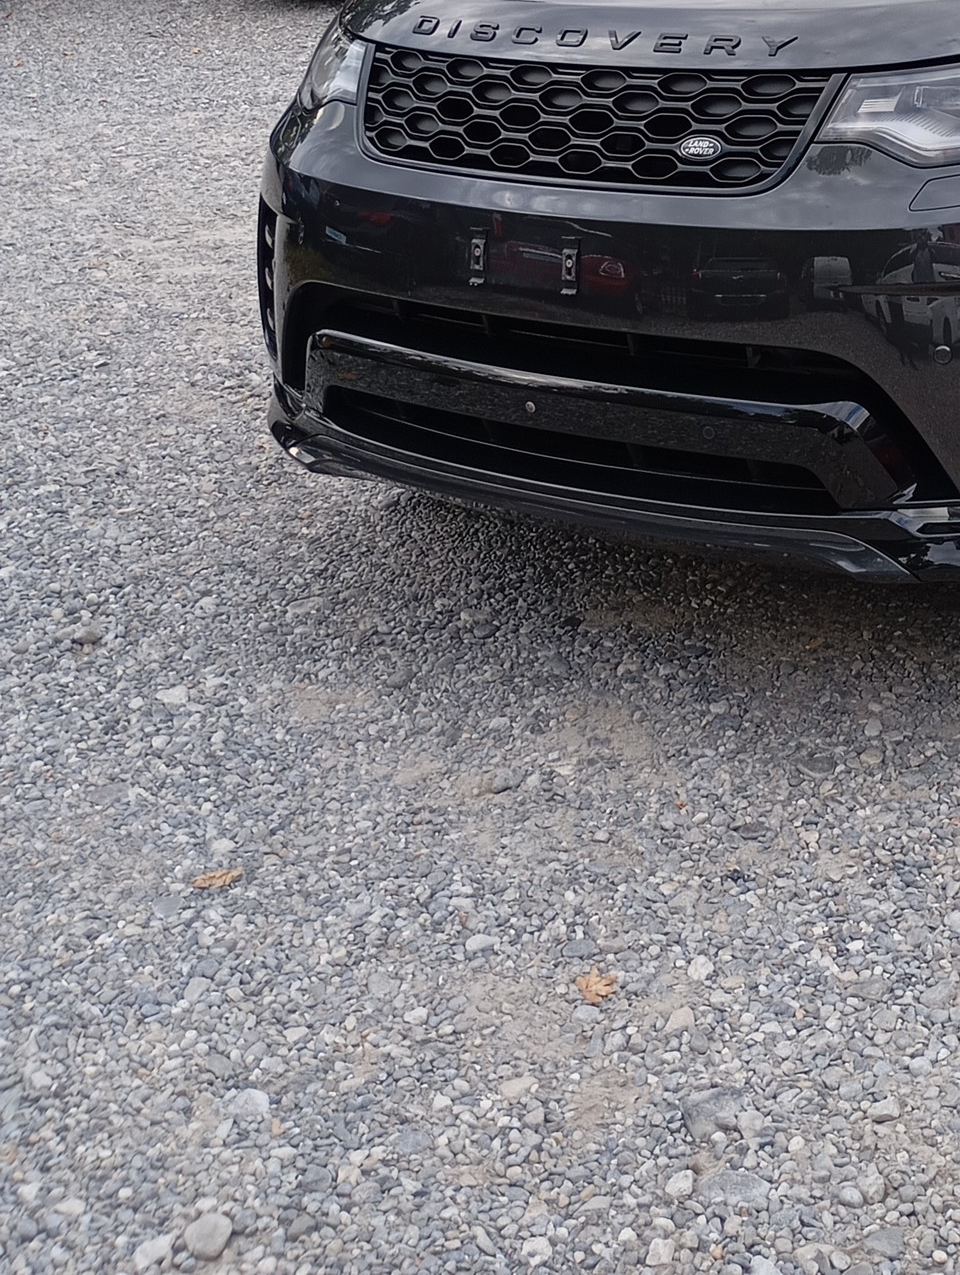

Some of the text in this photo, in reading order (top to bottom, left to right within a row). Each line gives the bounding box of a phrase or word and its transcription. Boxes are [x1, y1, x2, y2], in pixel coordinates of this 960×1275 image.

[411, 14, 800, 58] DISCOVERY
[688, 140, 710, 148] LAND
[688, 147, 715, 155] ROVER
